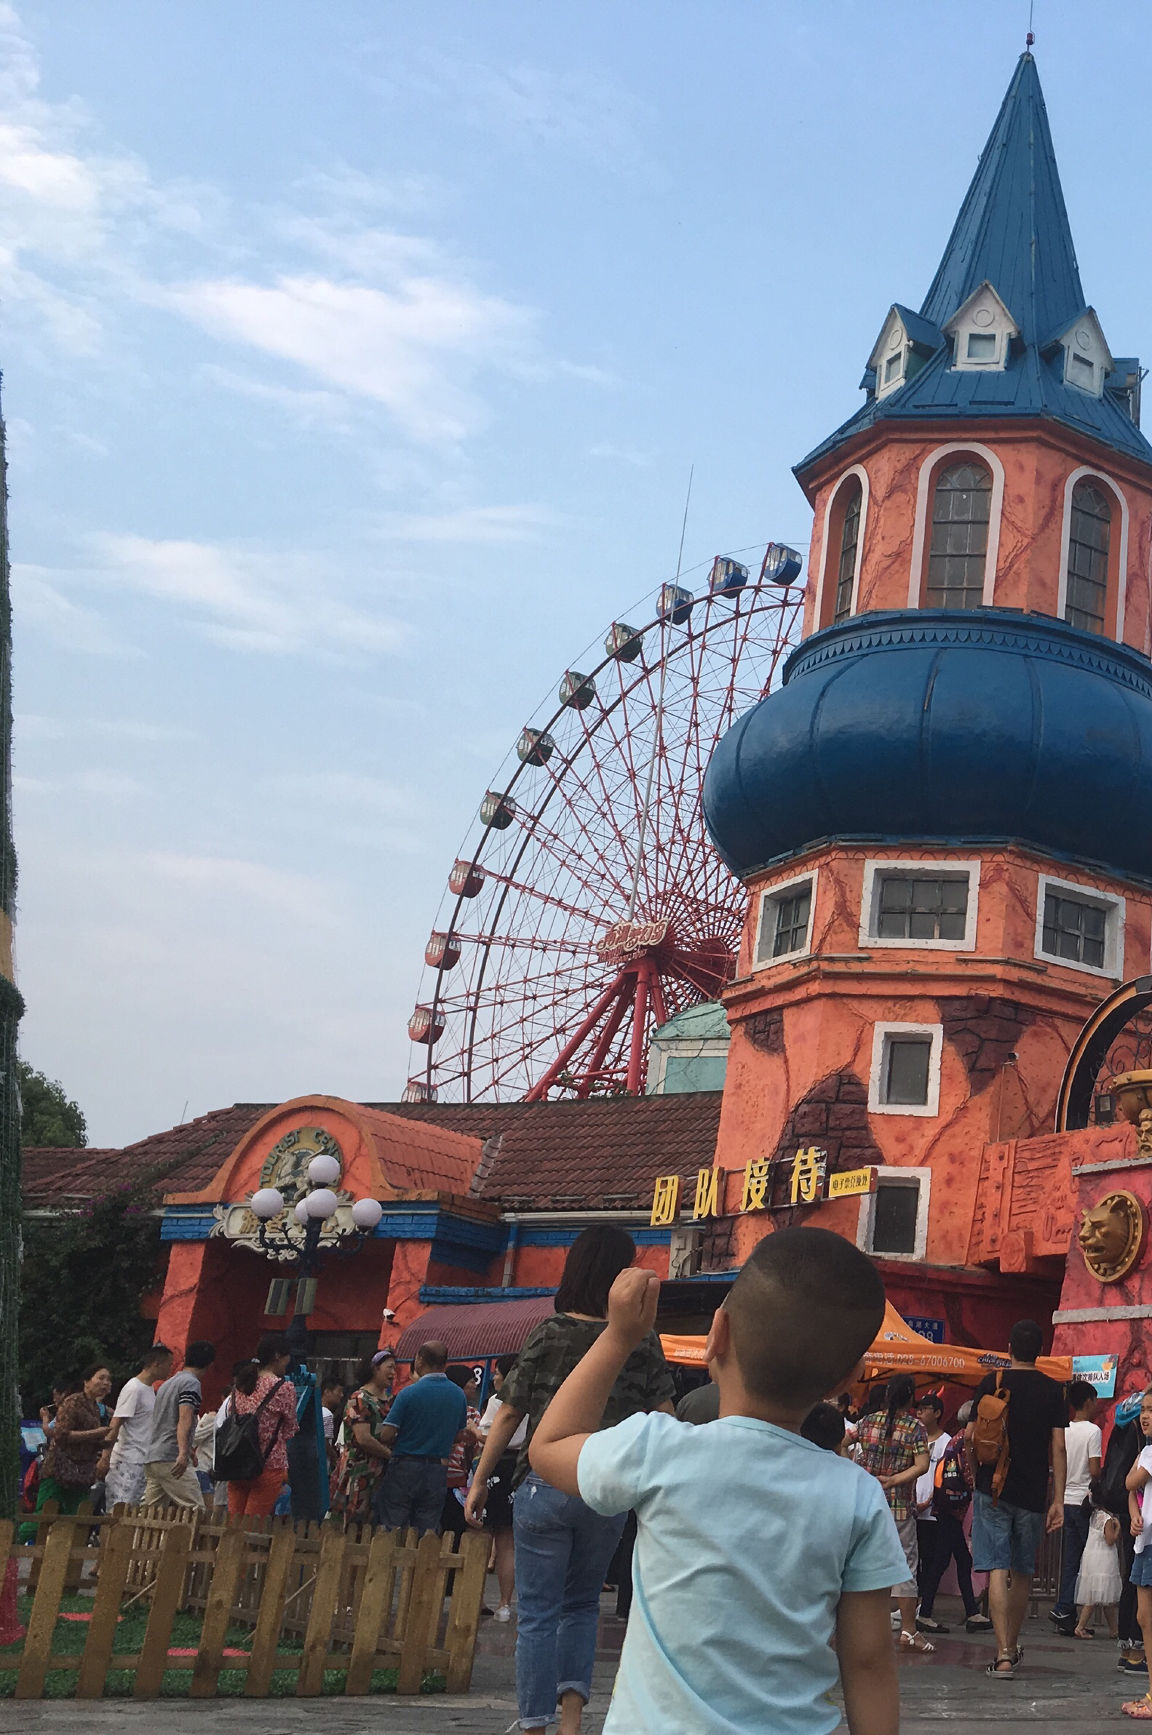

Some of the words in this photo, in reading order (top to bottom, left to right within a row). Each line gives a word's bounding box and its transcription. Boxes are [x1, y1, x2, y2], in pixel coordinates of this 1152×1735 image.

[260, 1129, 301, 1187] TOURIST
[650, 1146, 825, 1226] 团队接待
